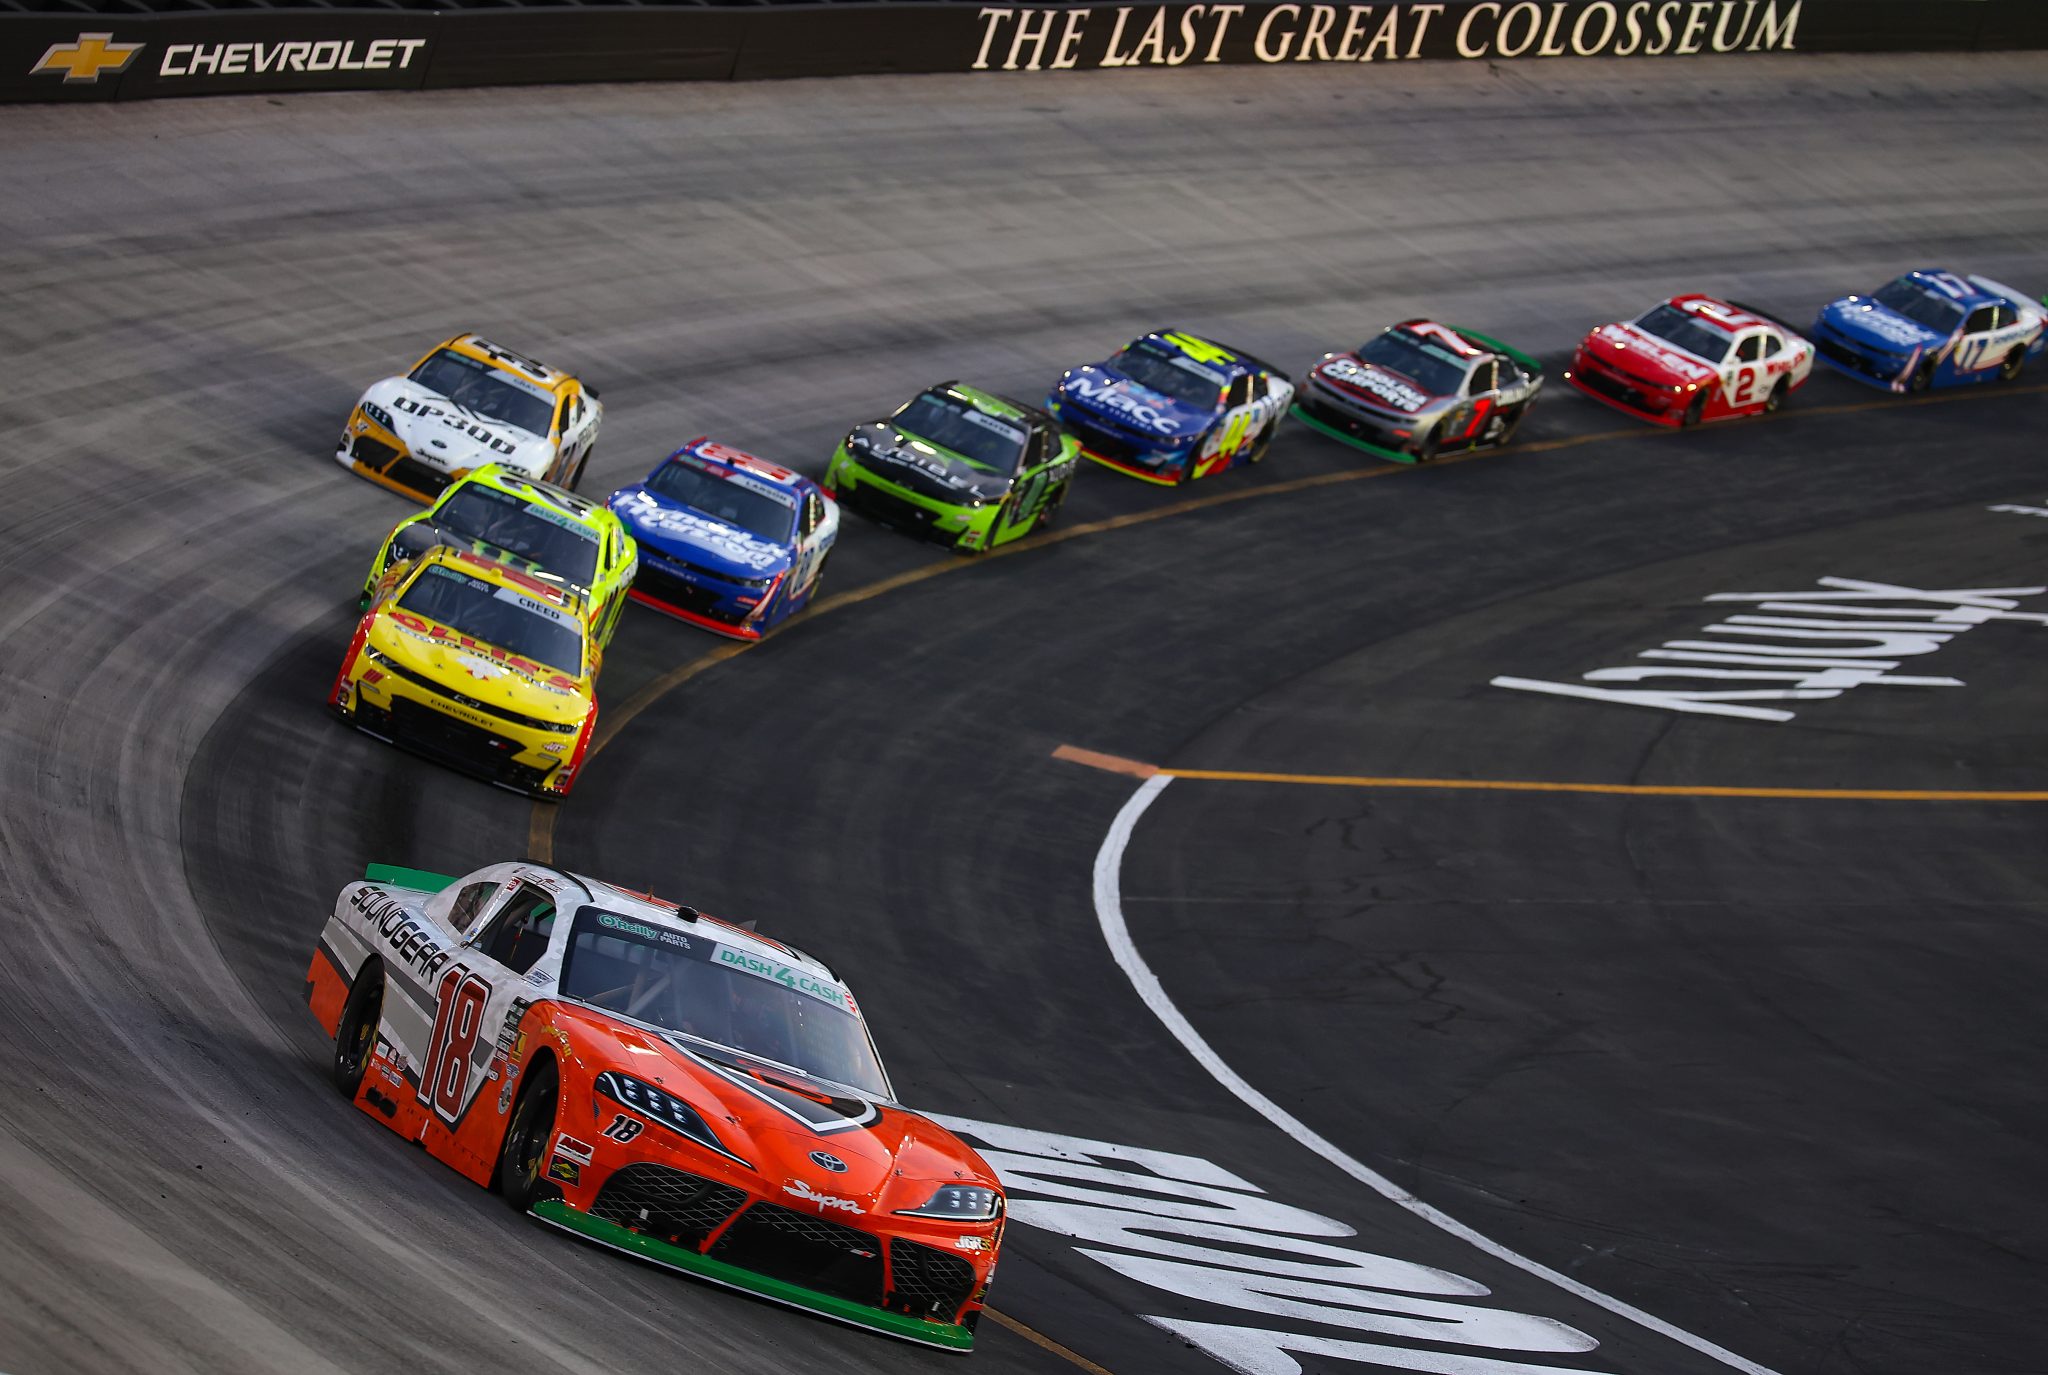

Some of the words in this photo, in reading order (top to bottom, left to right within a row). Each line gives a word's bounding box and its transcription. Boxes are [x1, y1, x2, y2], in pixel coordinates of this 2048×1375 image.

[971, 7, 1090, 71] THE
[1099, 3, 1245, 67] LAST
[1254, 3, 1444, 64] GREAT
[1455, 1, 1800, 58] COLOSSEUM
[159, 38, 426, 76] CHEVROLET
[1959, 338, 1989, 370] 17
[1736, 367, 1756, 403] 2
[1464, 398, 1493, 438] 1
[518, 597, 561, 621] CREED
[350, 886, 450, 985] SOUNDGEAR
[597, 913, 659, 940] O'Reilly
[659, 935, 692, 950] PARTS
[663, 931, 688, 943] AUTO
[720, 949, 772, 976] DASH
[774, 966, 796, 988] 4
[799, 978, 845, 1006] CASH
[417, 962, 492, 1135] 18
[602, 1114, 644, 1143] 18
[782, 1178, 868, 1214] Supra
